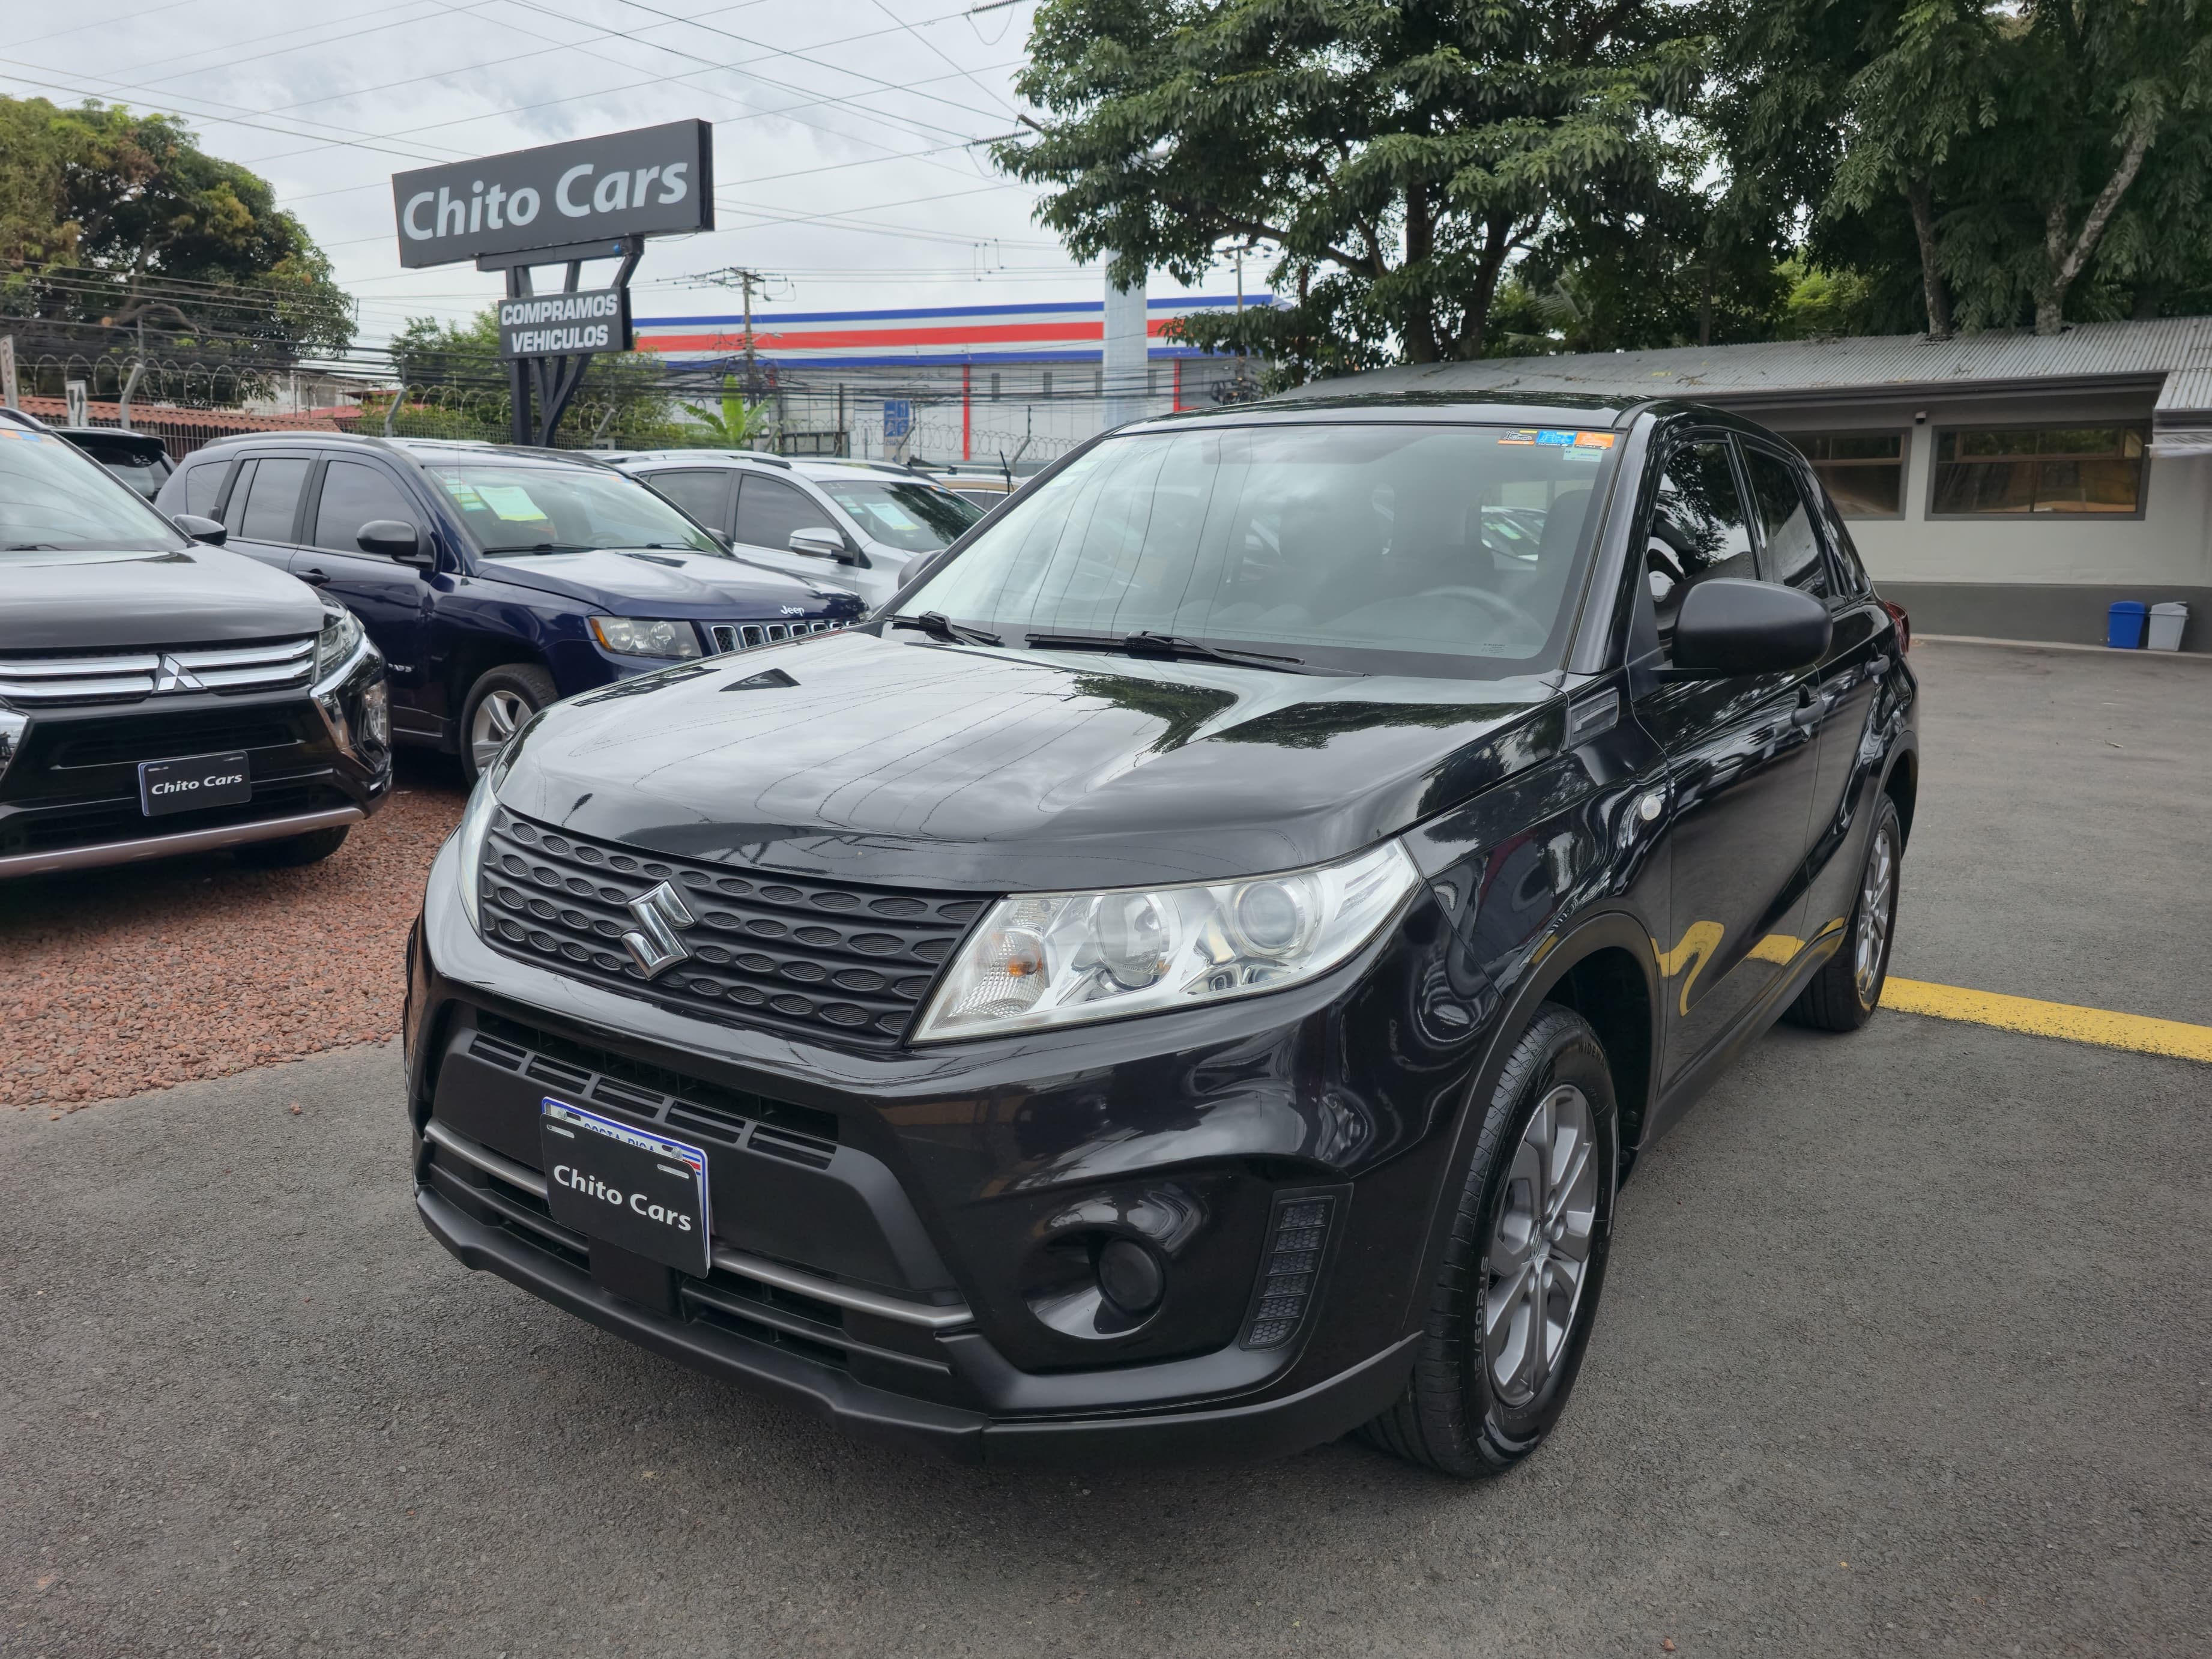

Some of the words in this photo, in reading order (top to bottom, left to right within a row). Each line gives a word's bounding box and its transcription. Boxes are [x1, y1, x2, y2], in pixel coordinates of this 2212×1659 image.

[403, 180, 540, 241] Chito
[555, 163, 688, 218] Cars
[501, 294, 618, 326] COMPRAMOS
[512, 324, 609, 354] VEHICULOS
[780, 605, 805, 617] Jeep
[151, 781, 200, 795] Chito
[203, 775, 243, 787] Cars
[553, 1165, 623, 1205] Chito
[629, 1193, 691, 1231] Cars
